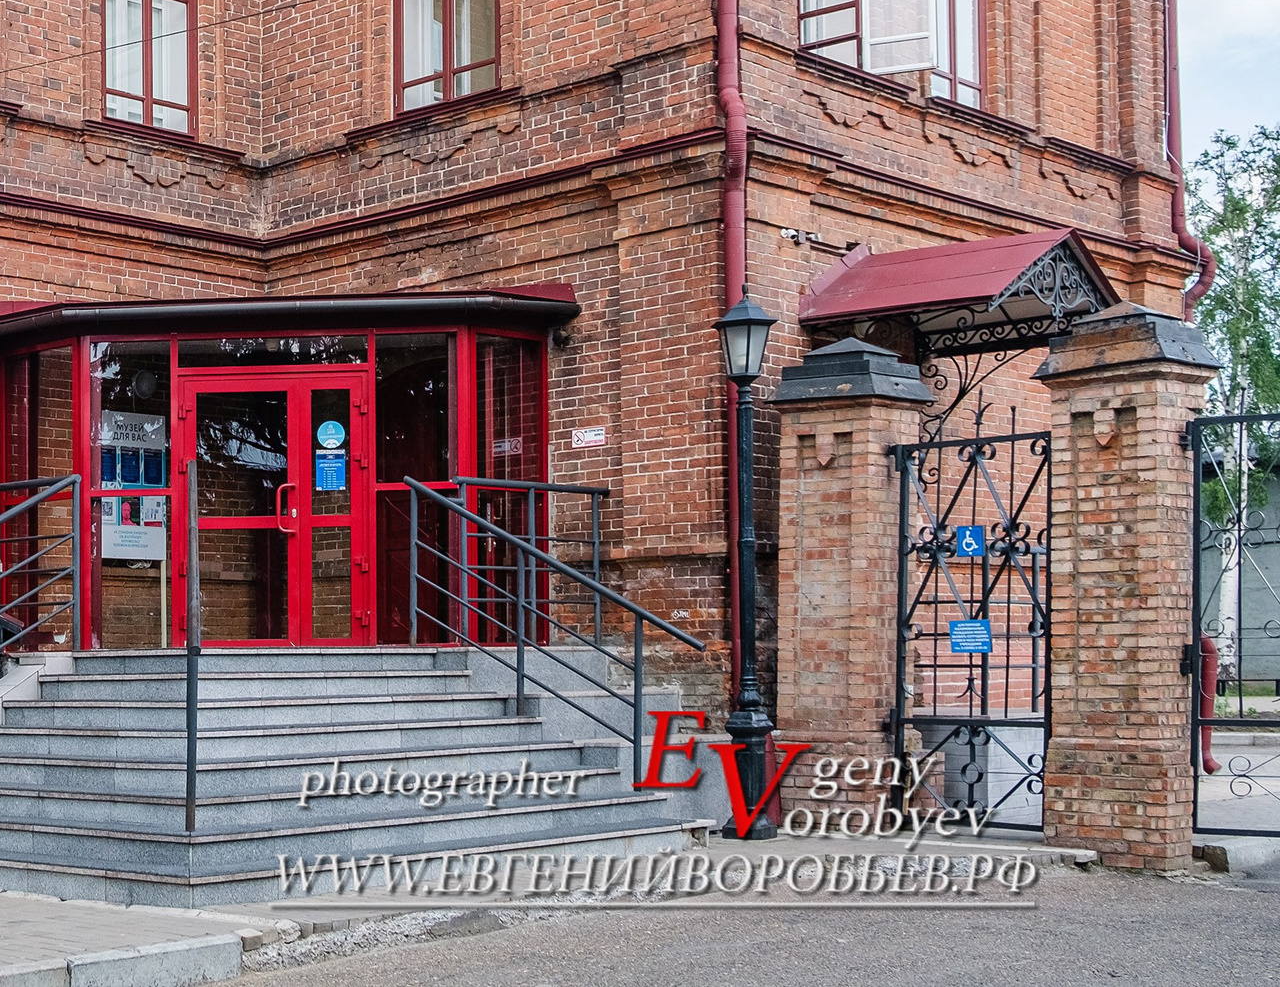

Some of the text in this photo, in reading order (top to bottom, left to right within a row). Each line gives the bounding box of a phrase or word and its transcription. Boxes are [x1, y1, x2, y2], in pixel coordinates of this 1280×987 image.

[116, 423, 144, 432] МУЗЕЙ
[113, 432, 147, 442] ДЛЯ ВАС
